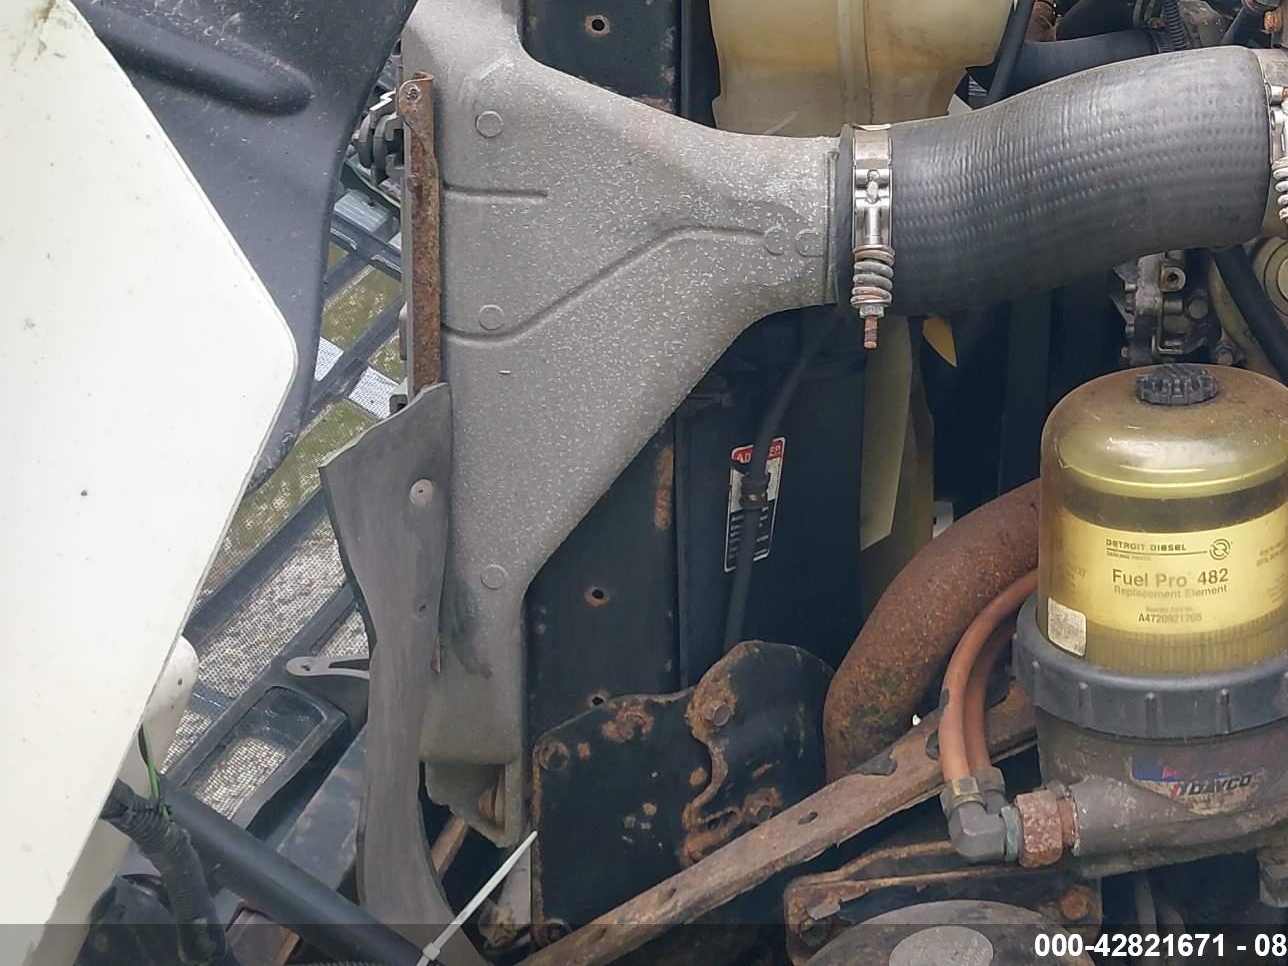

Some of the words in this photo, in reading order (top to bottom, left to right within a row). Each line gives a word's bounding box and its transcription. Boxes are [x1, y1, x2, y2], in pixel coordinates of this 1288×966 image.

[1106, 538, 1145, 551] DETROIT
[1150, 543, 1186, 552] DIESEL
[1112, 568, 1148, 587] Fuel
[1156, 573, 1188, 588] Pro
[1197, 567, 1229, 585] 482
[1114, 585, 1181, 599] Replacement
[1185, 584, 1227, 597] Element
